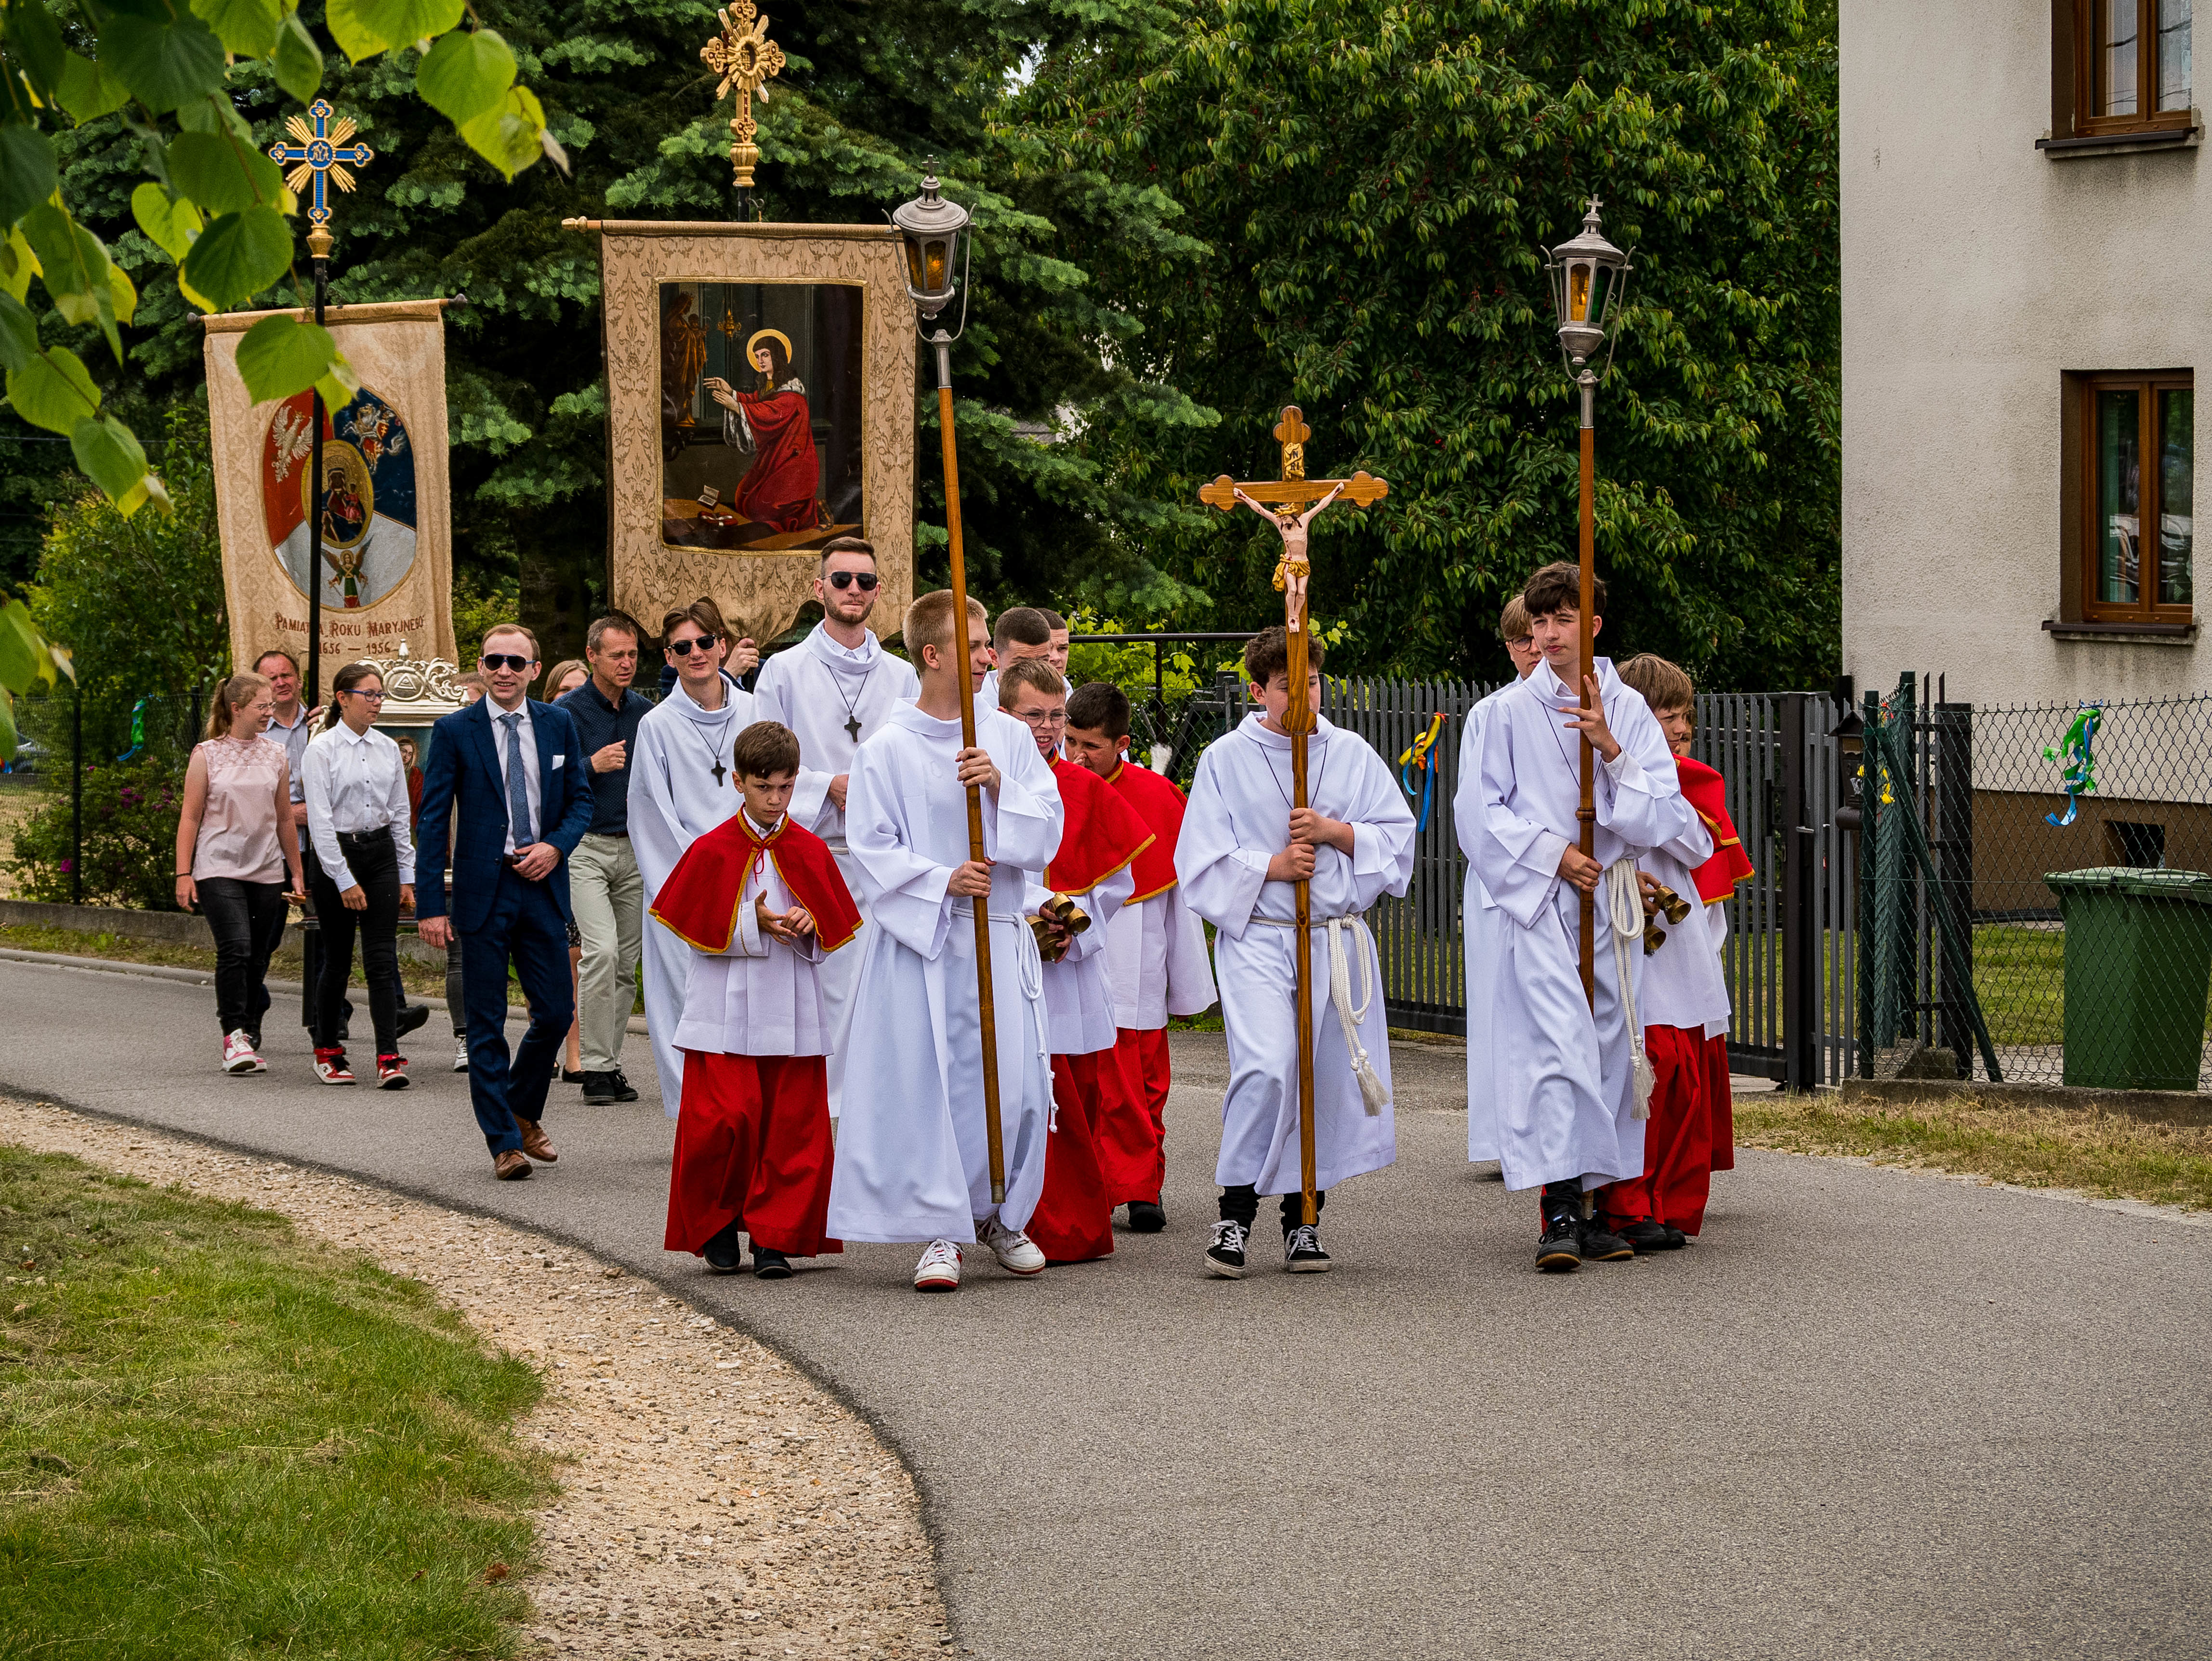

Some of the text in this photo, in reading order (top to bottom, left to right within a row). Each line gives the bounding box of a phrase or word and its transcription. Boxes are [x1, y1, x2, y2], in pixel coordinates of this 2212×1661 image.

[329, 620, 361, 638] ROKU
[319, 642, 340, 654] 1656
[366, 641, 391, 654] 1956
